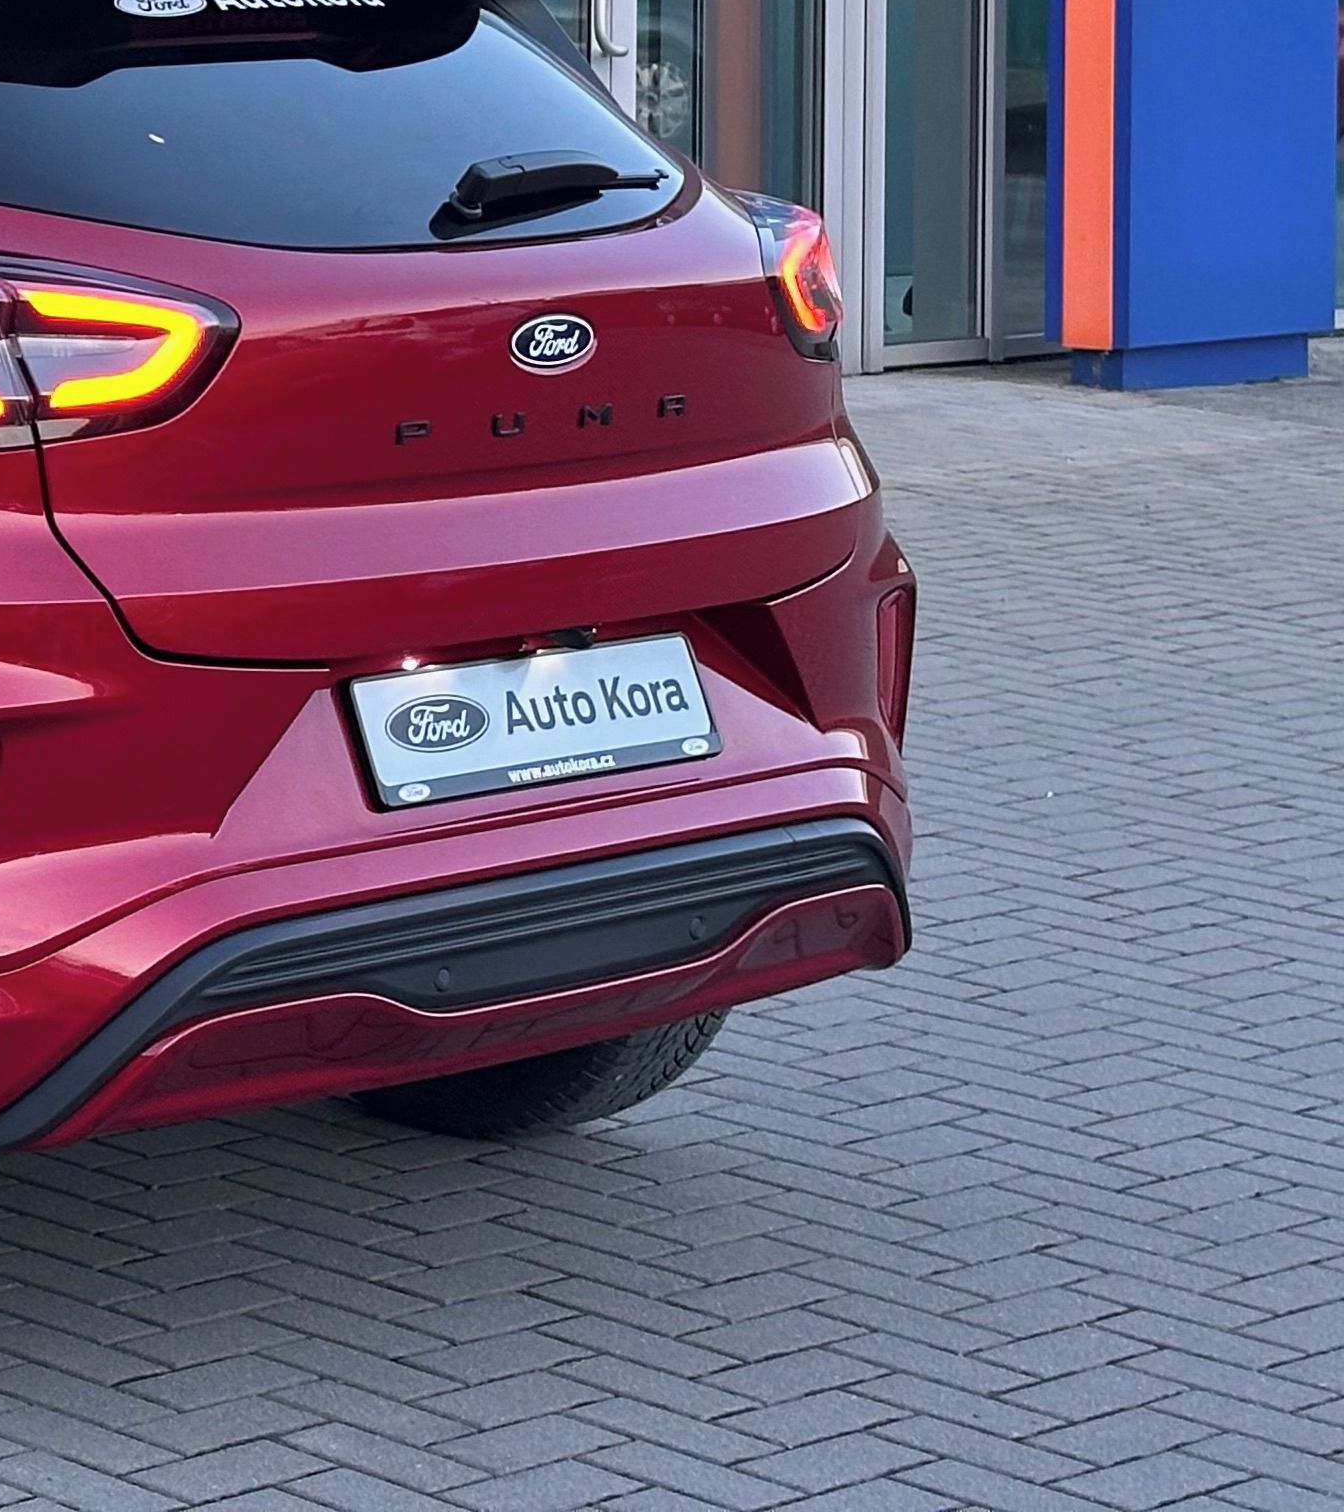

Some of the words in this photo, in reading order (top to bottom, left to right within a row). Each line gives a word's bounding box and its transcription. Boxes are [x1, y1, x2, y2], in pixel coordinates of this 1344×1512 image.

[529, 322, 579, 357] Ford
[395, 393, 687, 445] PUMA
[408, 702, 471, 744] Ford
[506, 685, 597, 735] Auto
[598, 675, 690, 721] Kora
[507, 754, 617, 783] www.autokora.cz
